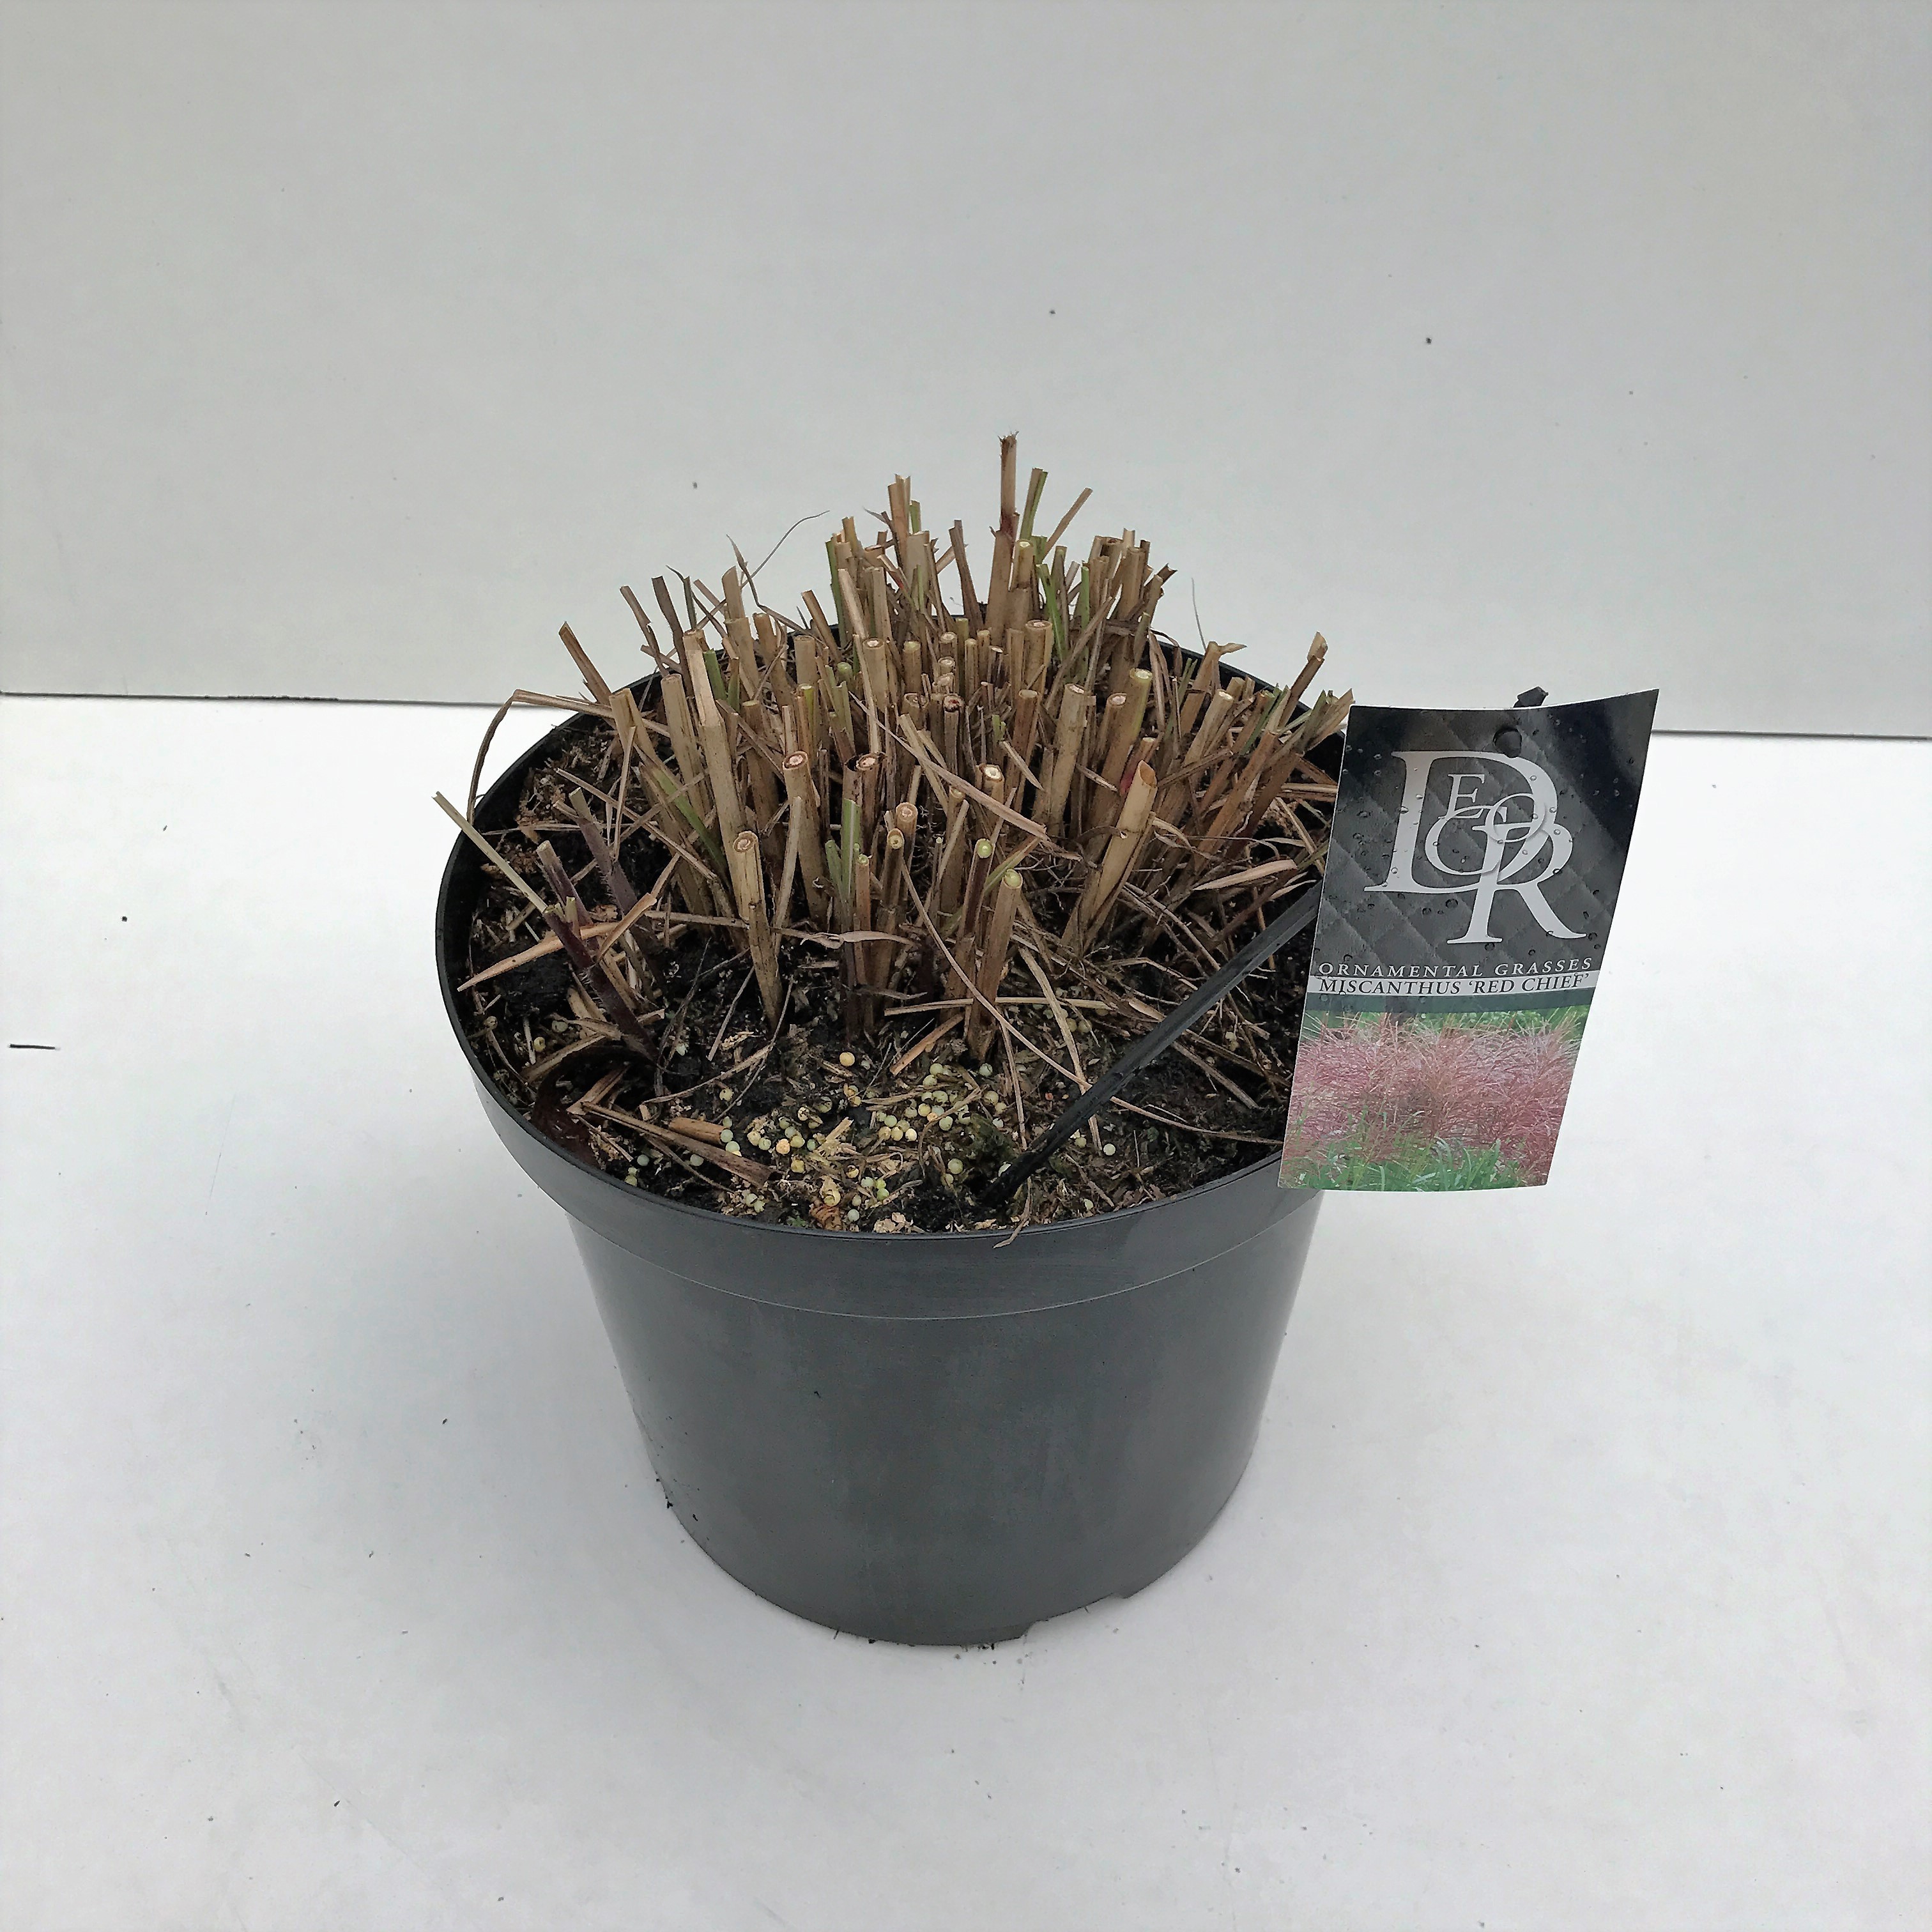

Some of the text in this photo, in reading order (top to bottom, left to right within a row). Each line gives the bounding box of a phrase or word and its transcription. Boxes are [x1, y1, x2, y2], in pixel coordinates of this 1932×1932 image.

[1319, 957, 1593, 978] ORNAMENTAL GRASSES
[1319, 978, 1461, 995] MISCANTHUS
